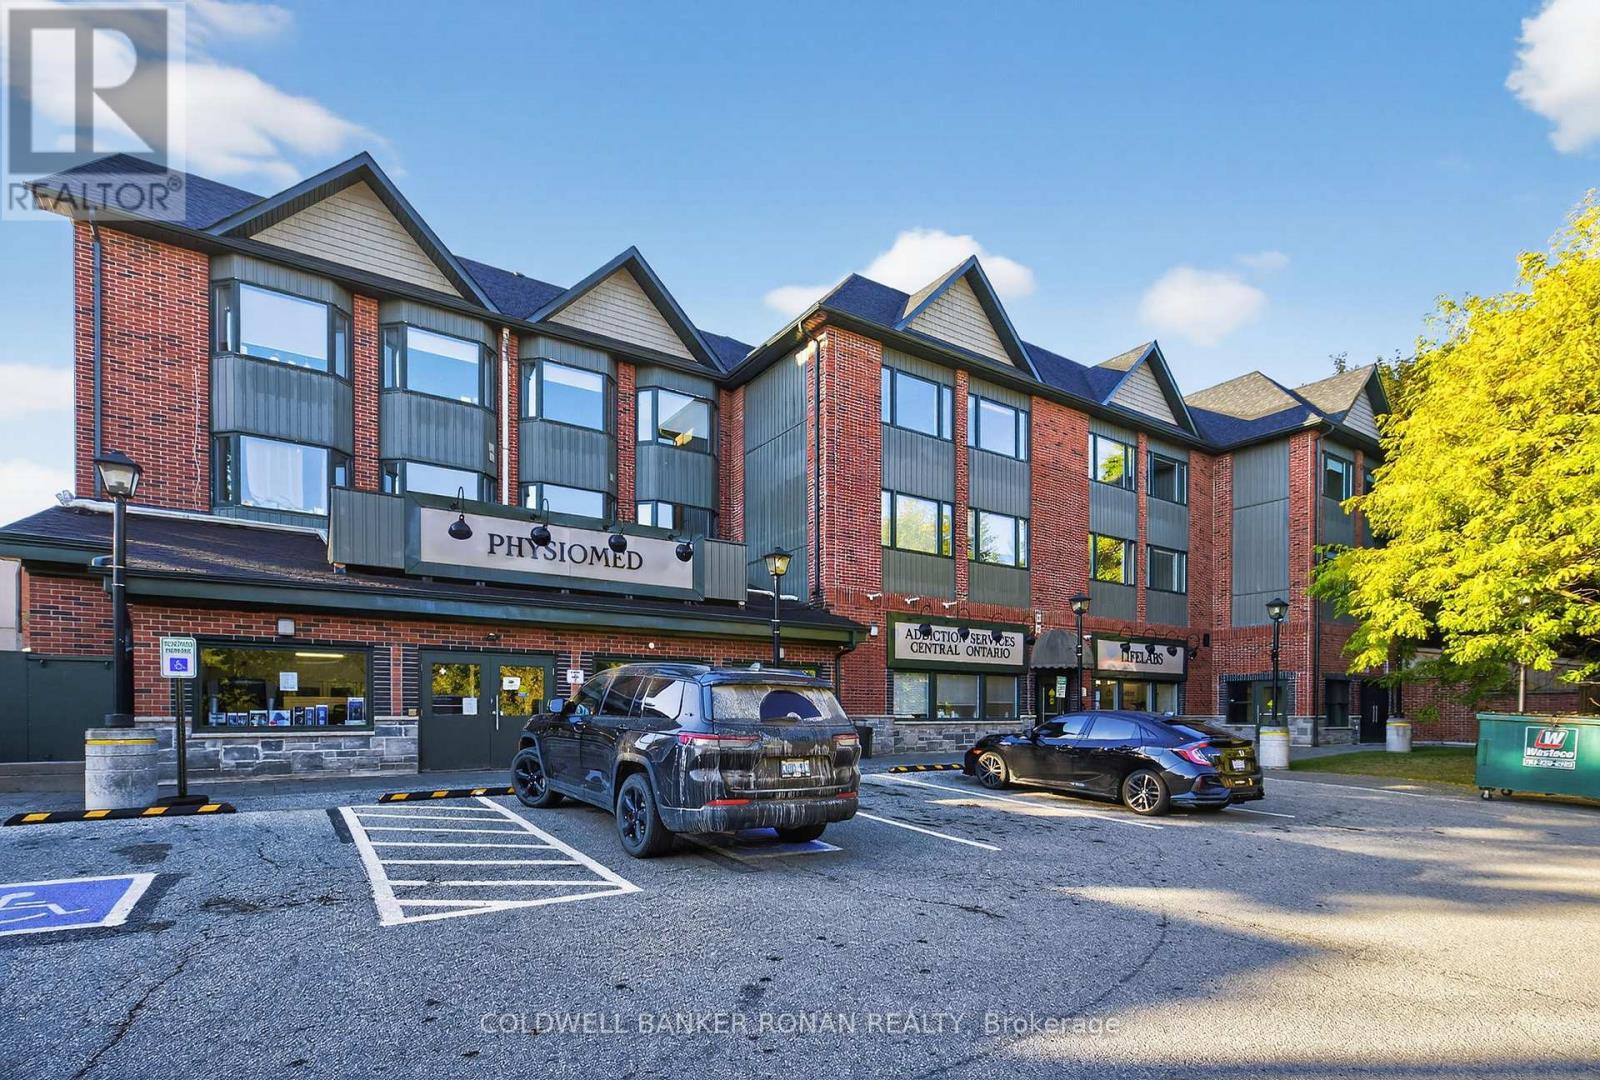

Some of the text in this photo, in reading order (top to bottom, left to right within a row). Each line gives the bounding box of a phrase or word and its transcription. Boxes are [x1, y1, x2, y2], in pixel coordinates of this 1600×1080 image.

[487, 533, 643, 570] PHYSIOMED
[910, 641, 1011, 659] CENTRAL ONTARIO
